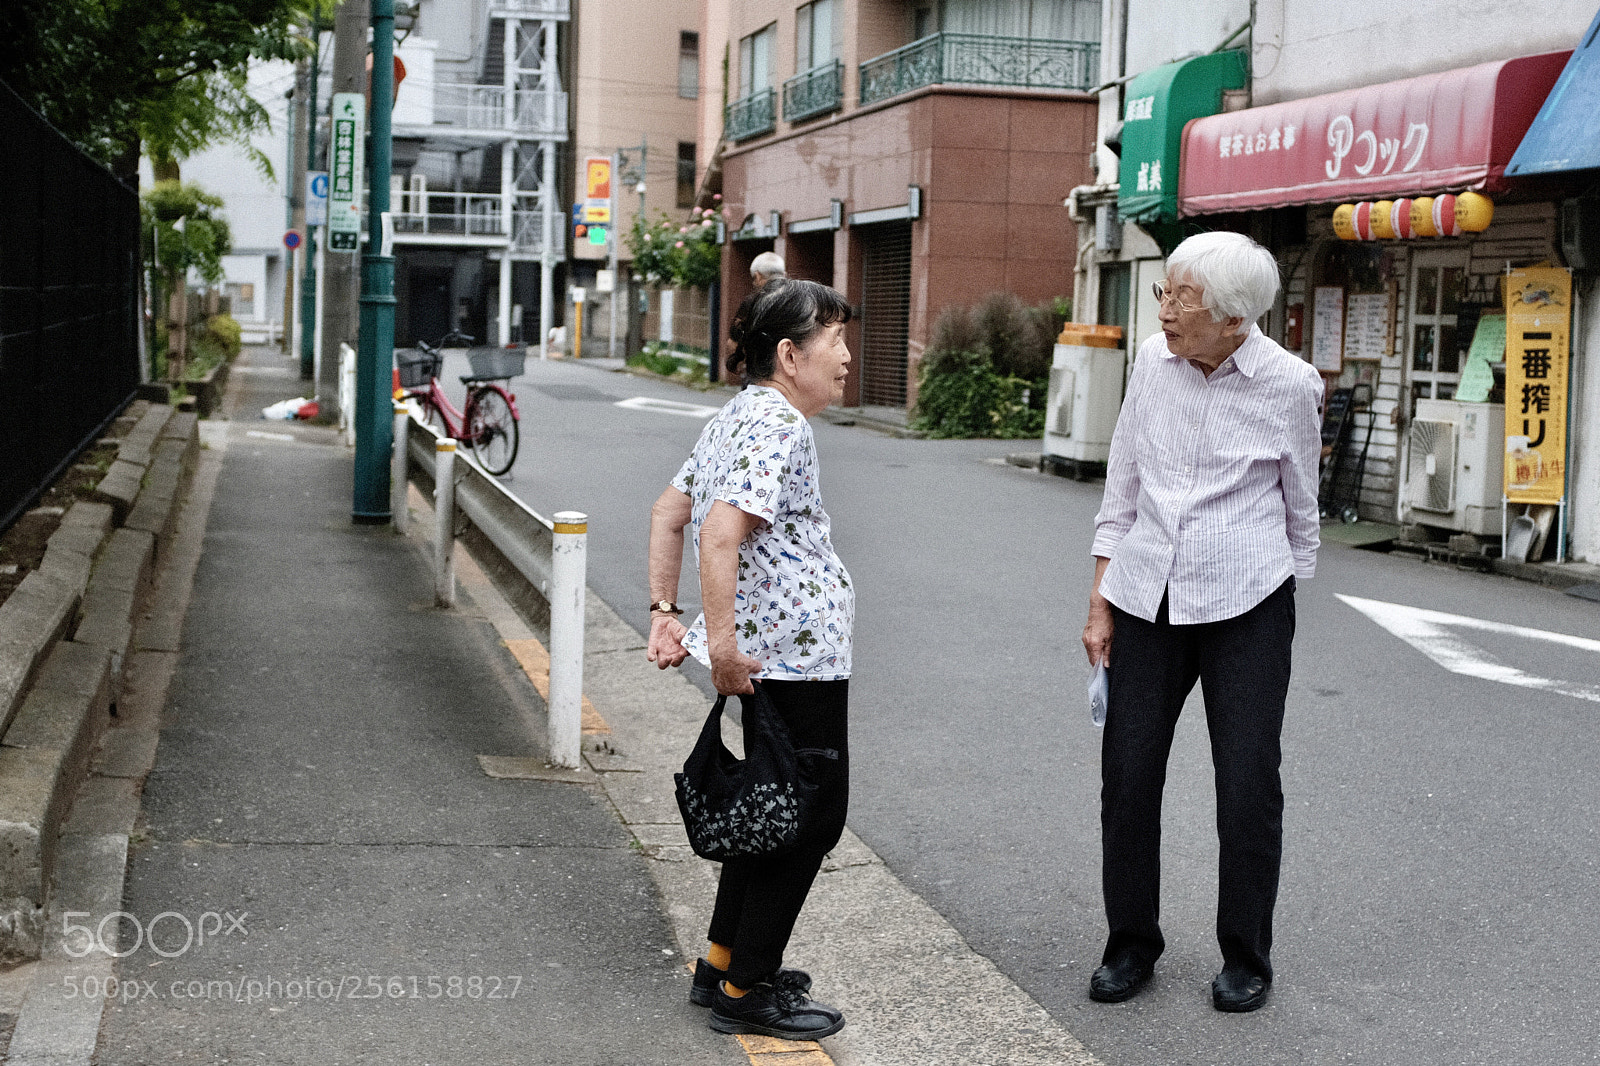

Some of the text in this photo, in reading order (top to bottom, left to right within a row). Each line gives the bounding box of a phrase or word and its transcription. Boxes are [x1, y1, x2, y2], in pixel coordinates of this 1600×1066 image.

[589, 163, 610, 195] P
[1522, 331, 1552, 448] 一番搾り
